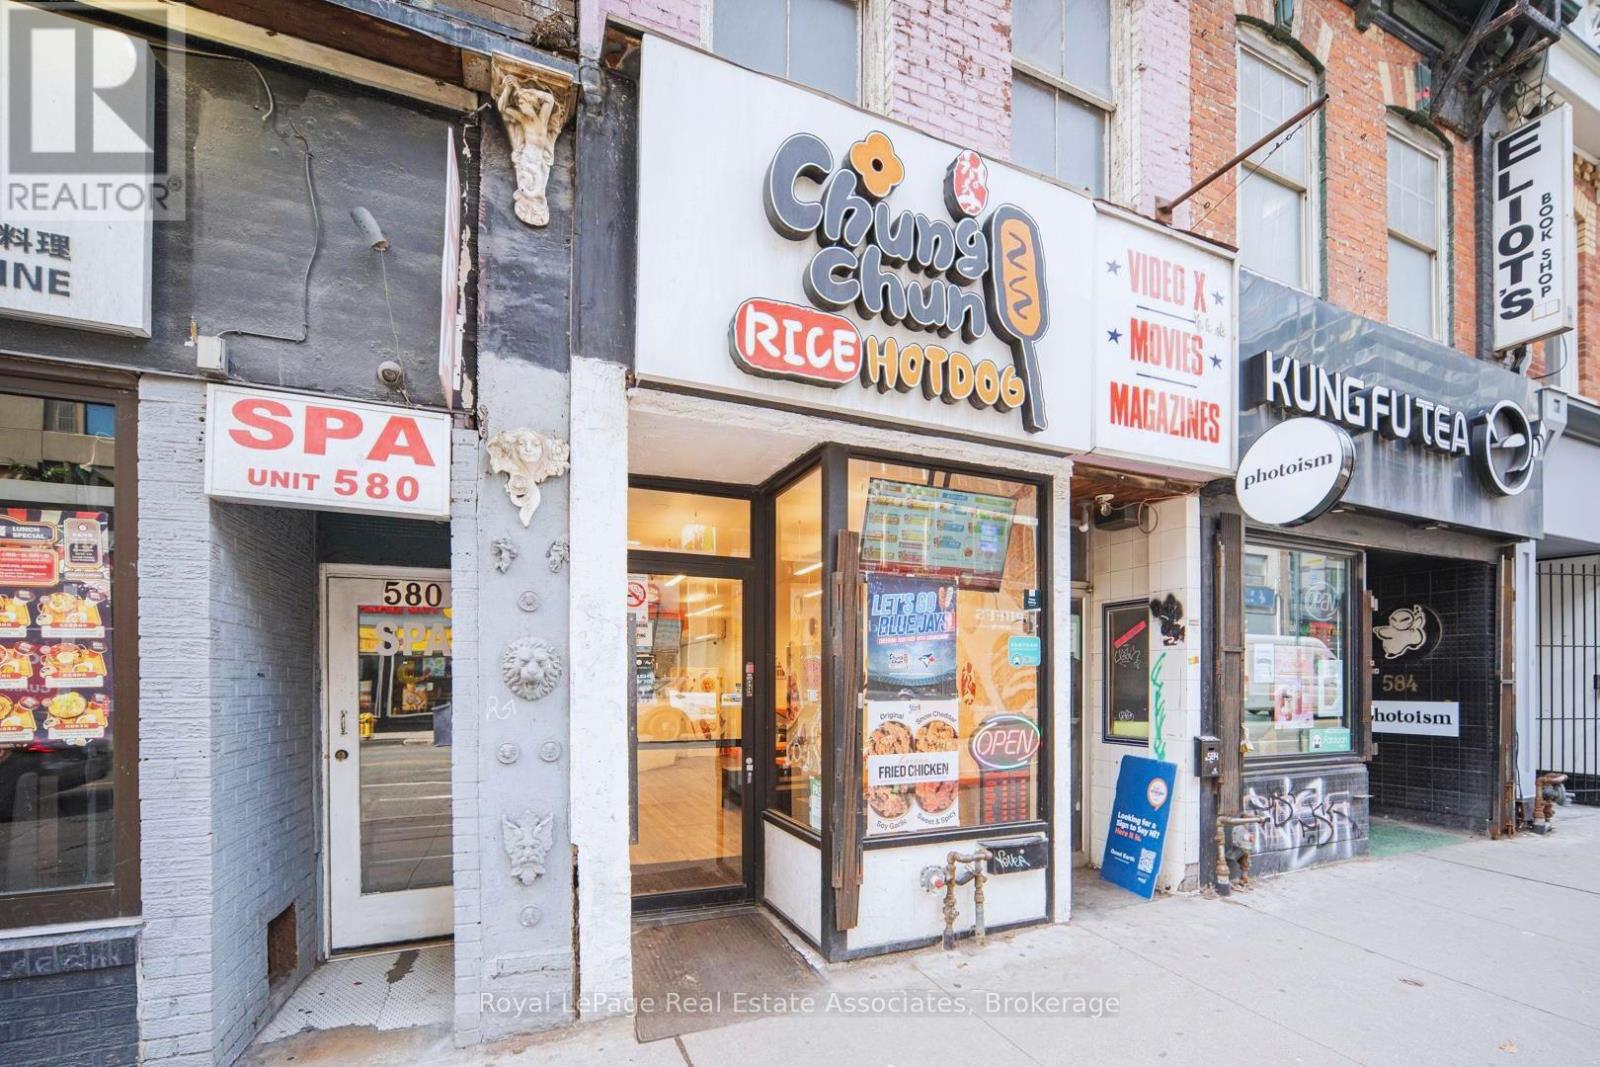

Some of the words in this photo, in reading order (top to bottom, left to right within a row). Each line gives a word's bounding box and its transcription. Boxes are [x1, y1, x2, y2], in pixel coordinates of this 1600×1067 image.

[764, 132, 989, 290] Chung
[1539, 192, 1554, 242] BOOK
[0, 223, 71, 262] 料理
[1127, 249, 1185, 306] VIDEO
[1193, 270, 1207, 313] X
[1538, 248, 1553, 298] SHOP
[744, 303, 858, 373] RICE
[864, 336, 1026, 410] HOTDOG
[1130, 318, 1204, 376] MOVIES
[1109, 381, 1221, 444] MAGAZINES
[1265, 350, 1366, 428] KUNG
[1371, 384, 1411, 440] FU
[1415, 398, 1471, 456] TEA
[228, 398, 436, 467] SPA
[247, 468, 320, 490] UNIT
[334, 470, 420, 501] 580
[1243, 452, 1334, 490] photoism
[12, 532, 46, 540] SPECIAL
[383, 581, 442, 607] 580
[871, 593, 915, 616] LET'S
[375, 621, 452, 657] SPA
[877, 614, 916, 636] BLUE
[1382, 674, 1418, 692] 584
[879, 711, 904, 721] Original
[1371, 708, 1452, 725] hotoism
[977, 729, 1033, 756] OPEN
[878, 764, 907, 779] FRIED
[907, 762, 949, 777] CHICKEN
[876, 820, 889, 831] Soy
[1117, 811, 1142, 826] Looking
[1141, 818, 1153, 828] for
[1130, 823, 1137, 832] to
